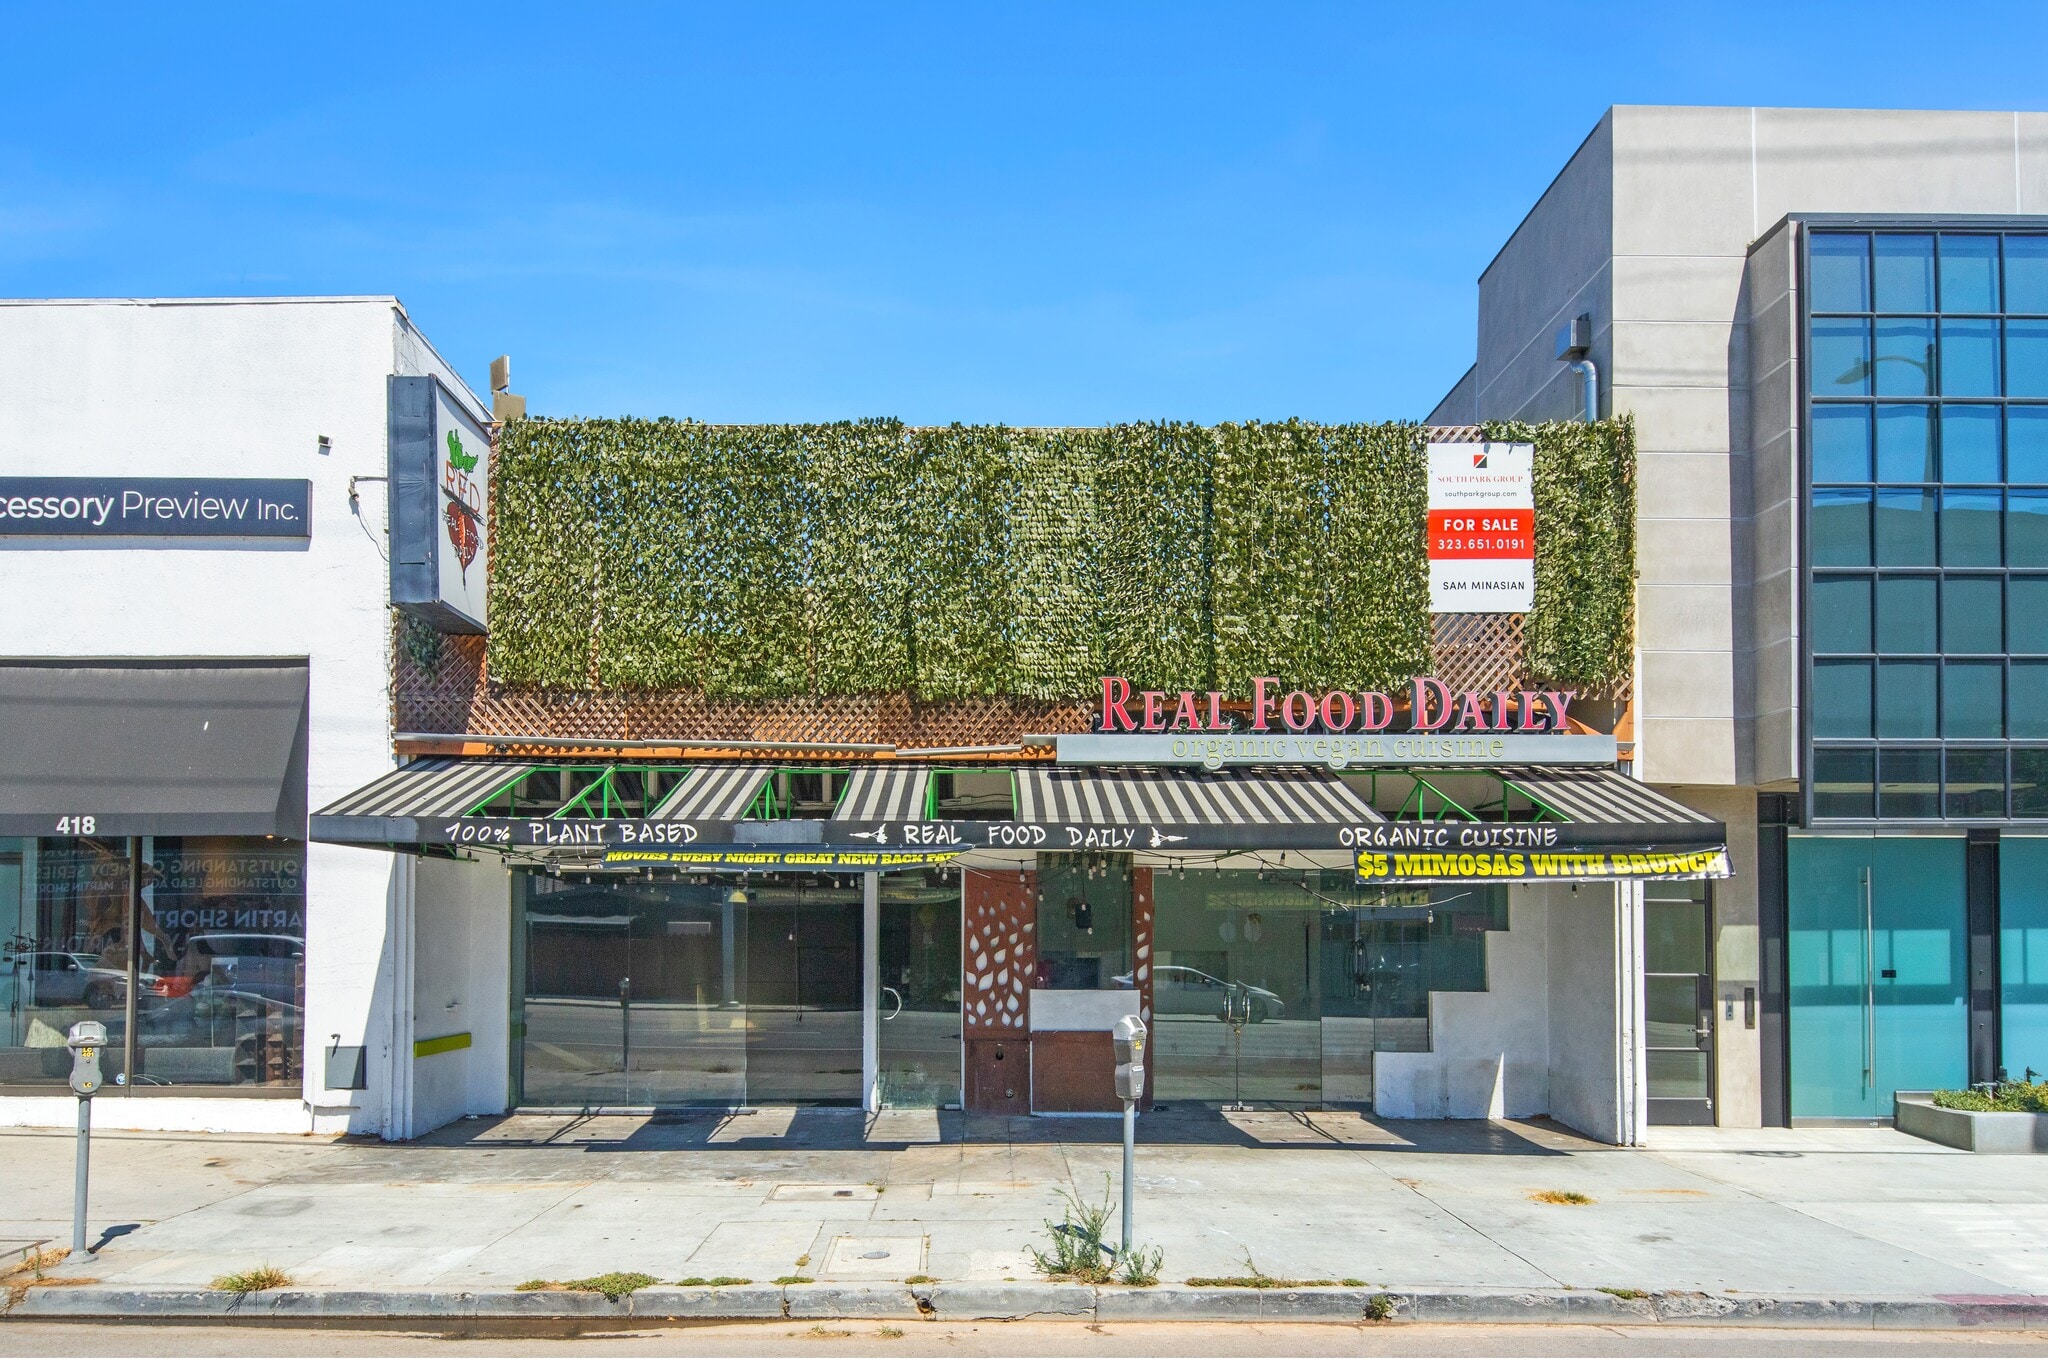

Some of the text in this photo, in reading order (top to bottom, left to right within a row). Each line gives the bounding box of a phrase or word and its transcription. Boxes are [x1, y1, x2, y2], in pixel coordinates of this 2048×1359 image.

[1438, 475, 1524, 483] SOUTH PARK GROUP
[1445, 490, 1517, 498] southparkgroup.com
[122, 491, 249, 520] Preview
[258, 498, 299, 520] Inc.
[1443, 519, 1518, 531] FOR SALE
[1438, 538, 1525, 550] 323.651.0191
[1443, 581, 1525, 591] SAM MINASIAN
[1098, 676, 1577, 732] REAL FOOD DAILY
[1172, 737, 1504, 767] organic vegan cuisine
[56, 815, 96, 835] 418
[446, 822, 698, 843] 100% PLANT BASED
[903, 824, 1135, 847] REAL FOOD DAILY
[1339, 826, 1558, 847] ORGANIC CUISINE
[605, 852, 668, 862] MOVIES
[670, 853, 723, 863] EVERY
[784, 853, 836, 864] GREAT
[837, 853, 879, 865] NEW
[881, 853, 923, 865] BACK
[1357, 851, 1725, 880] $5 MIMOSAS WITH BRUNCH
